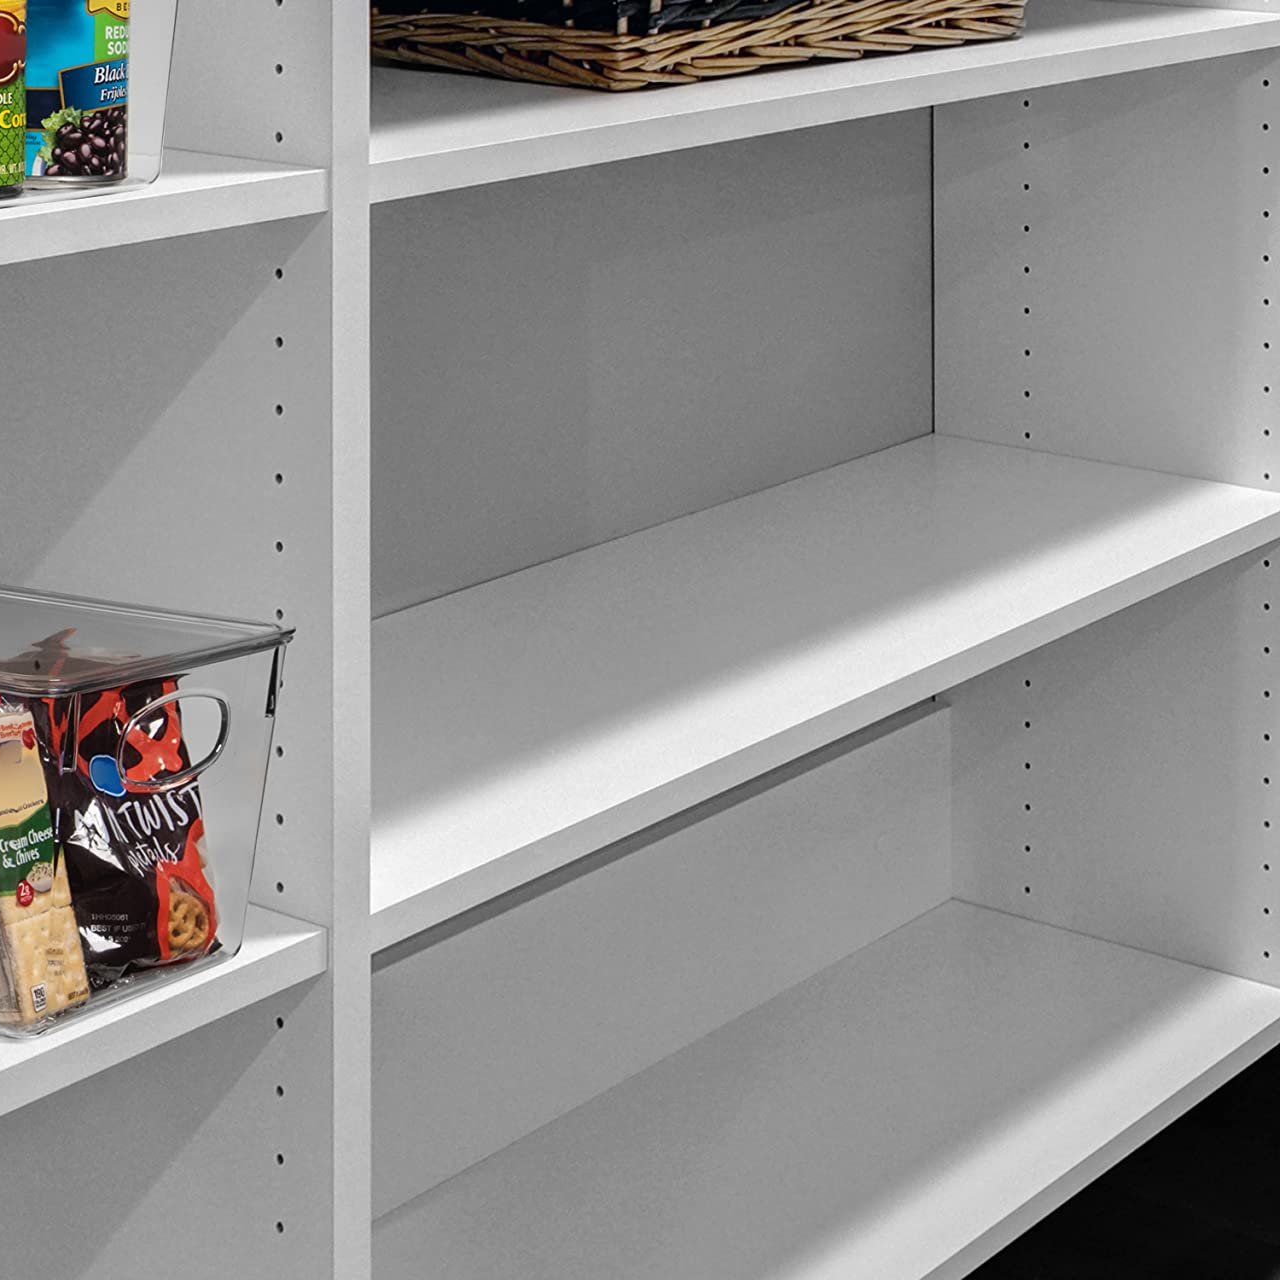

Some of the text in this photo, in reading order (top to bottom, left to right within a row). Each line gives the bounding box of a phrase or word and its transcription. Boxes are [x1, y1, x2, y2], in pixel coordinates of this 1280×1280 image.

[94, 64, 125, 84] Black
[28, 826, 54, 846] Cheese
[15, 846, 41, 867] Chives
